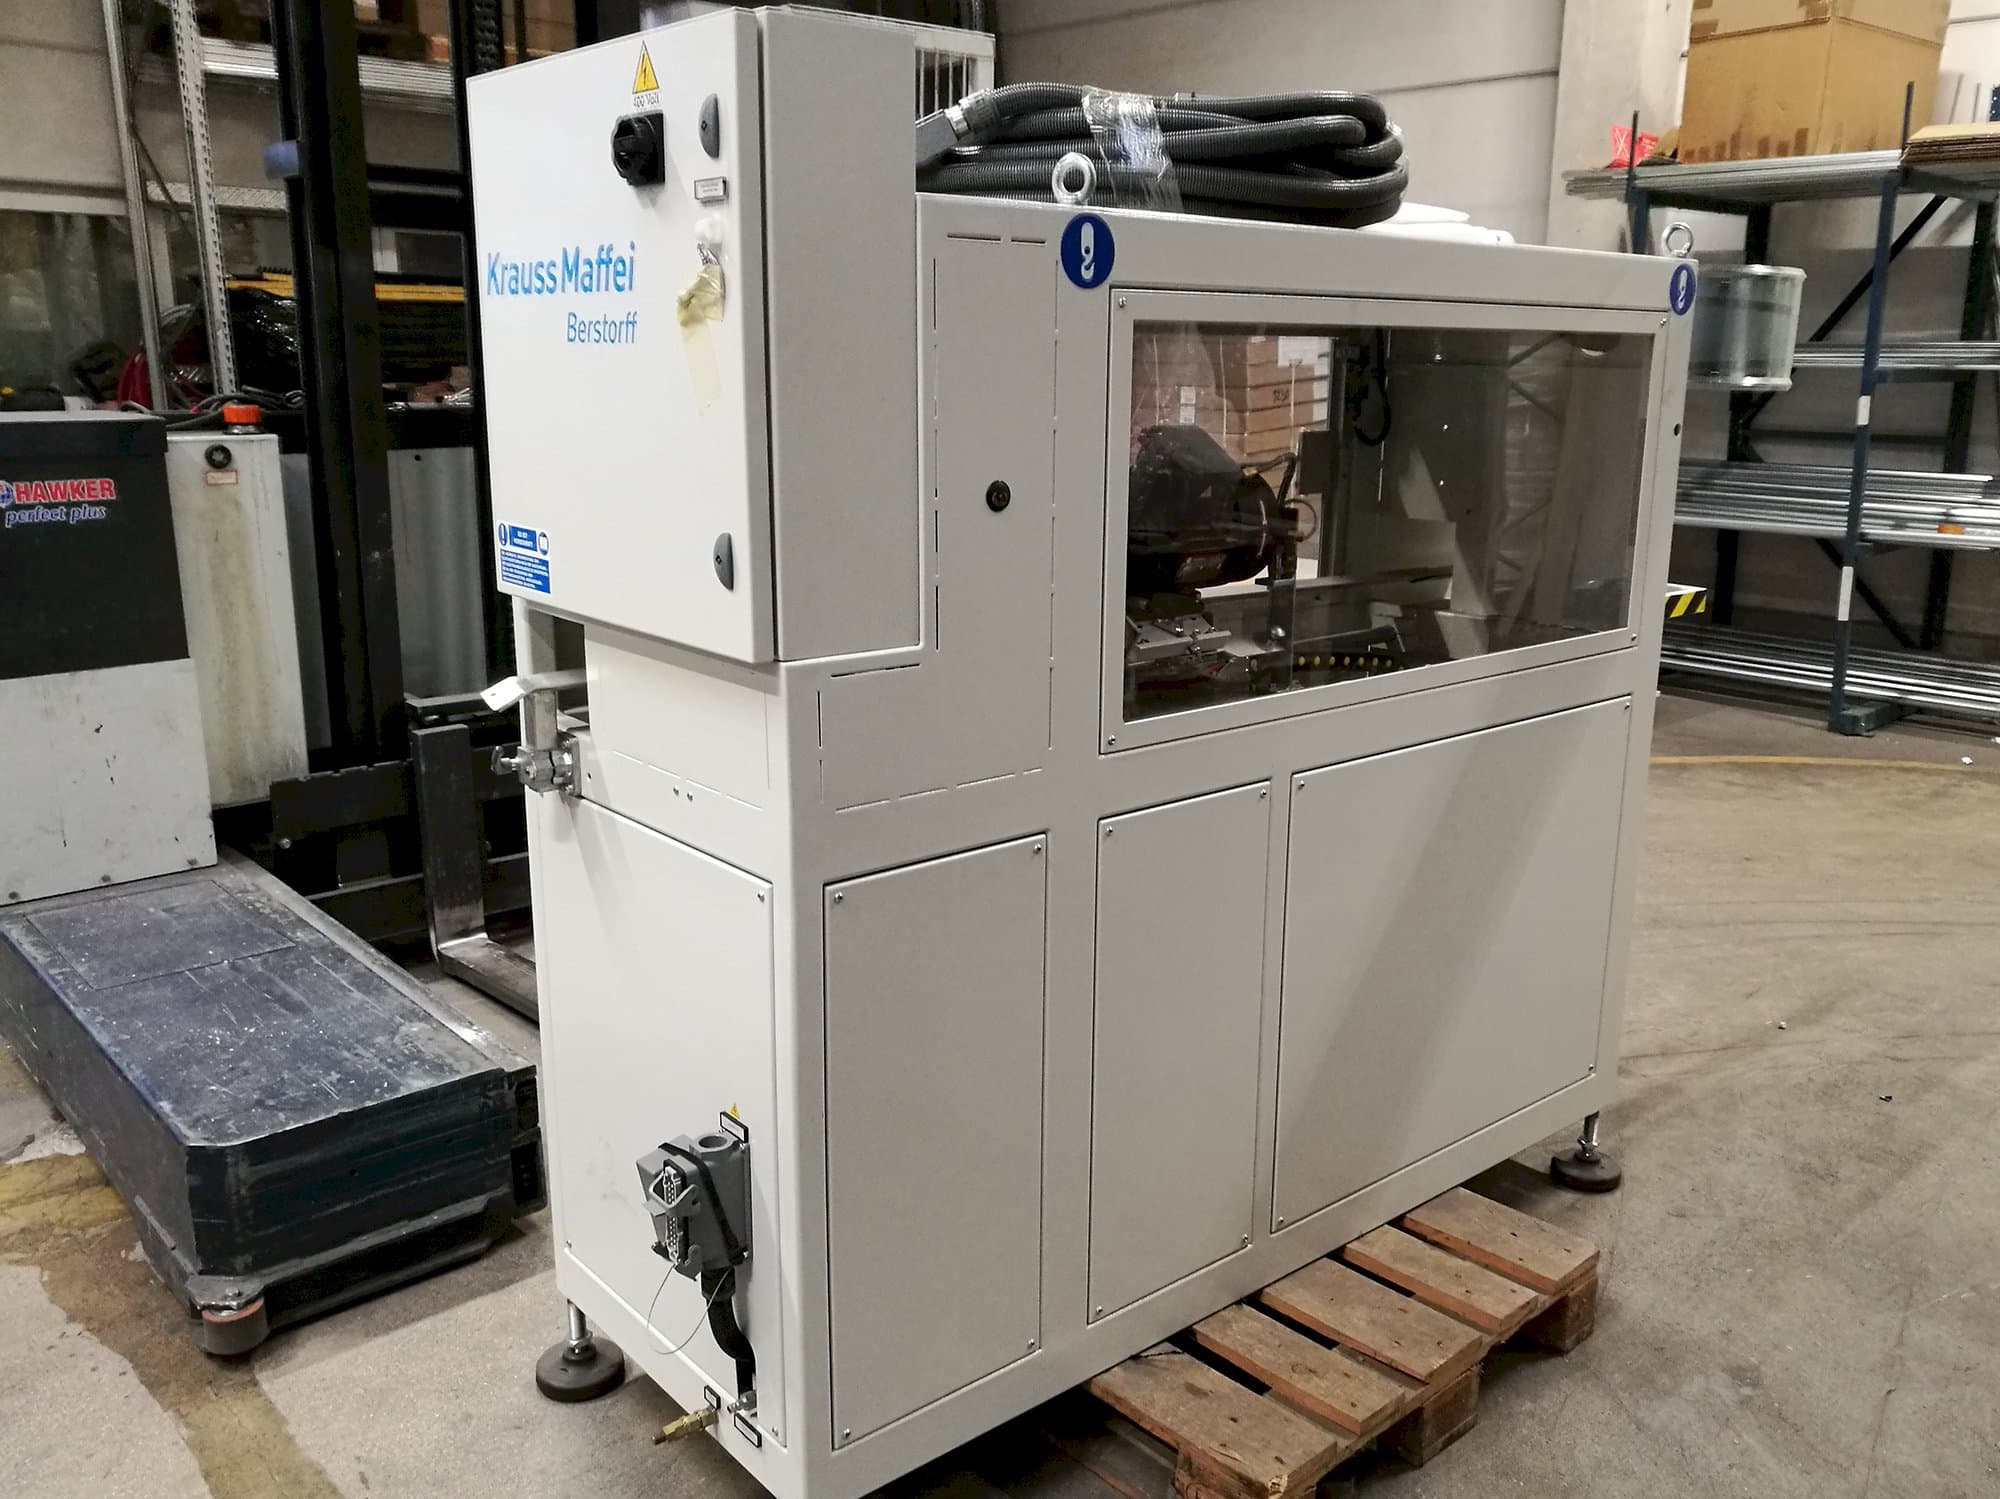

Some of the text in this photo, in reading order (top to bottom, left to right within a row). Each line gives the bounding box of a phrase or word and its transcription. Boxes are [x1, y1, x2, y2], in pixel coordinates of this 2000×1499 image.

[567, 311, 637, 344] Berstorff
[13, 478, 116, 504] HAWKER
[5, 504, 107, 528] perfect plus
